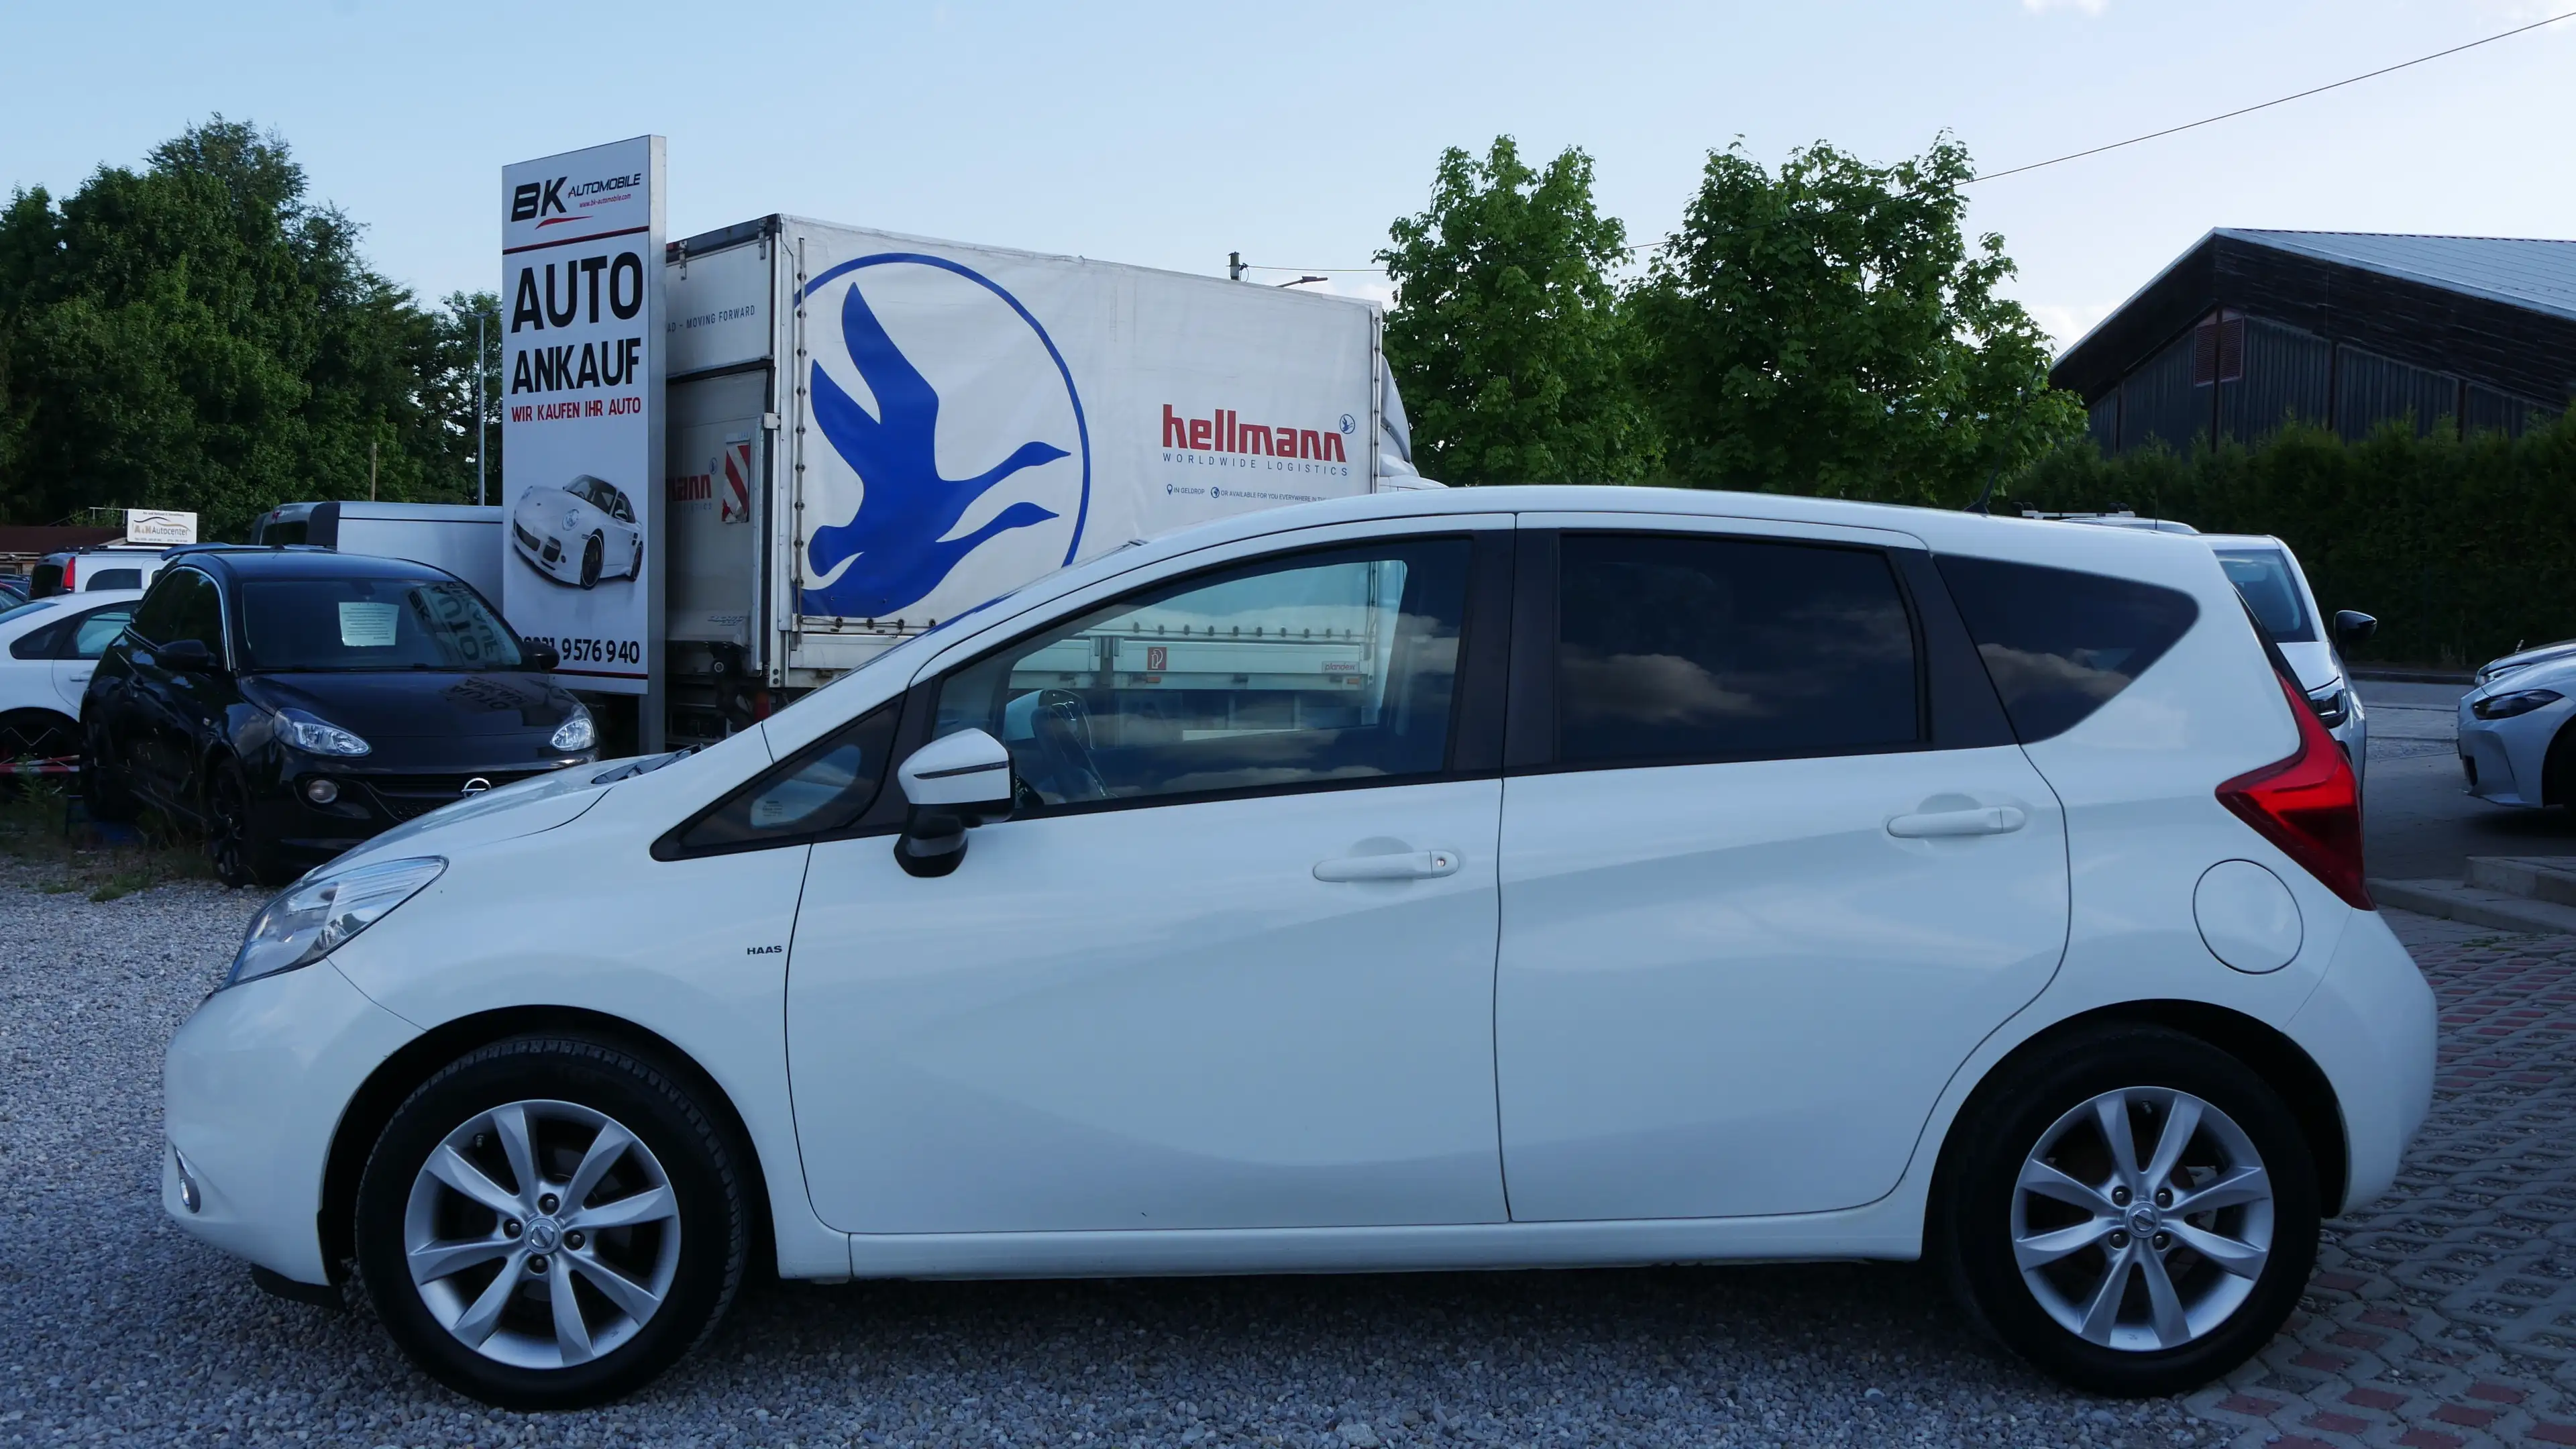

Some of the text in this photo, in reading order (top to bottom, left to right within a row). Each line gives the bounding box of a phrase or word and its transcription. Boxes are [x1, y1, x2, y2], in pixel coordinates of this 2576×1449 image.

[511, 173, 641, 222] BK AUTOMOBILE
[579, 193, 631, 208] www.bk-automobile.com
[511, 252, 643, 333] AUTO
[686, 313, 716, 329] MOVING
[718, 305, 755, 322] FORWARD
[511, 337, 641, 394] ANKAUF
[511, 396, 641, 423] WIR KAUFEN IHR AUTO
[1163, 404, 1347, 463] hellmann
[1163, 453, 1348, 476] WORLDWIDE LOGISTICS
[1229, 490, 1256, 498] AVAILABLE
[1279, 494, 1311, 502] EVERYWHERE
[747, 945, 783, 955] HAAS
